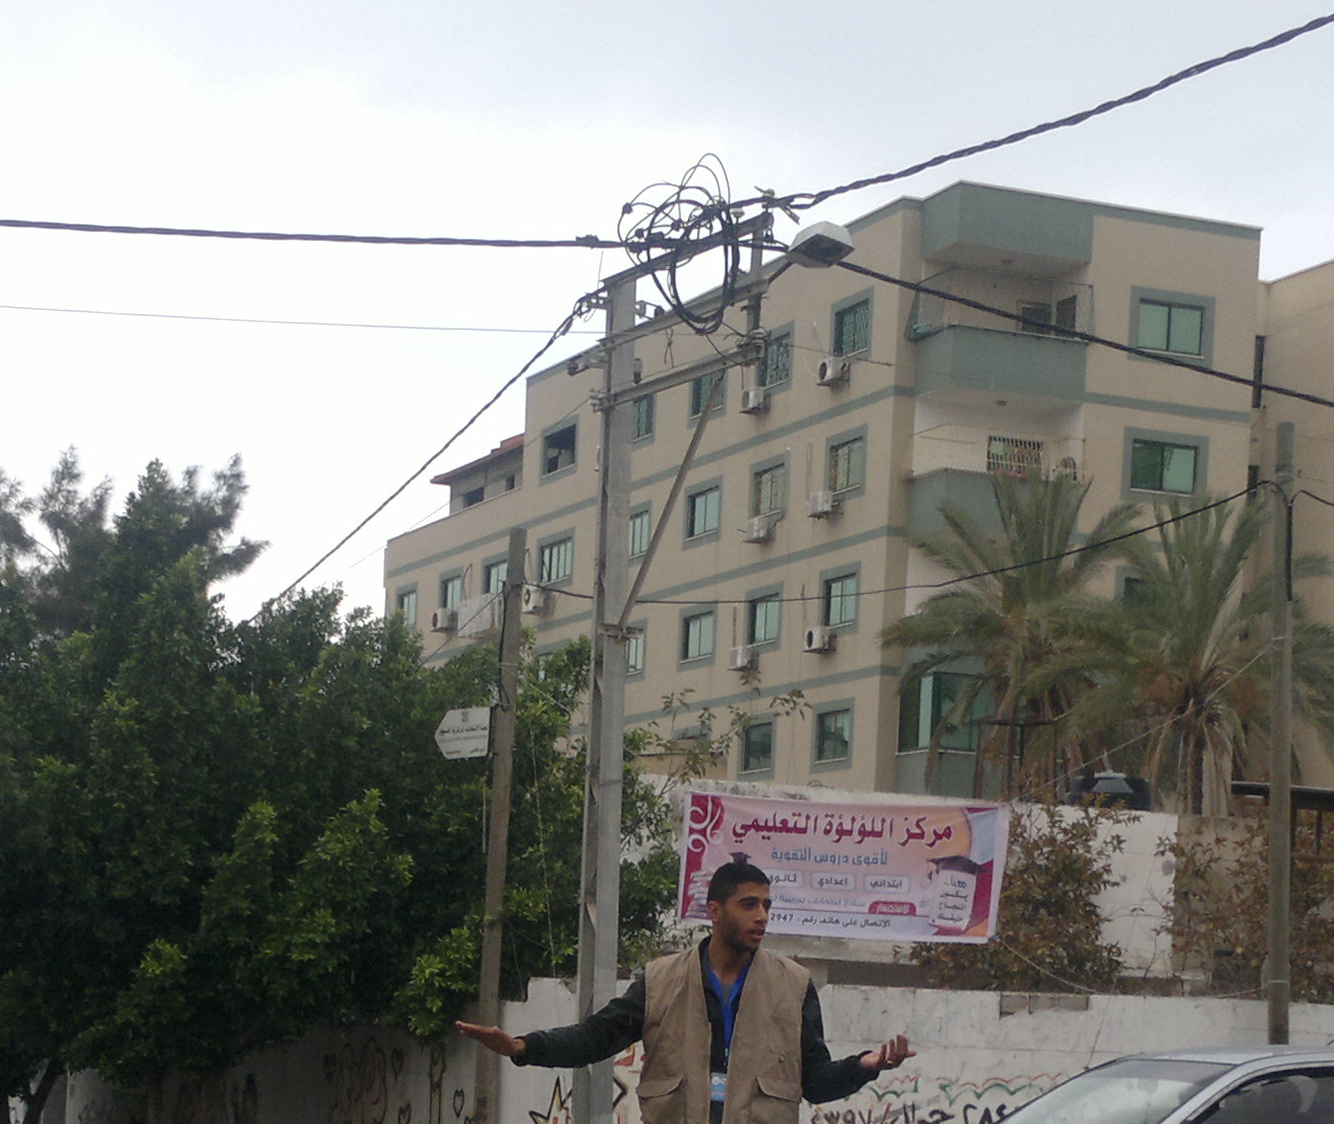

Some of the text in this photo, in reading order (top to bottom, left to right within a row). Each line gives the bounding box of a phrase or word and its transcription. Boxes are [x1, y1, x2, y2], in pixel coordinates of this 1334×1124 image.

[732, 812, 953, 848] مركز اللؤلؤة التعليمي
[814, 852, 849, 866] دروس
